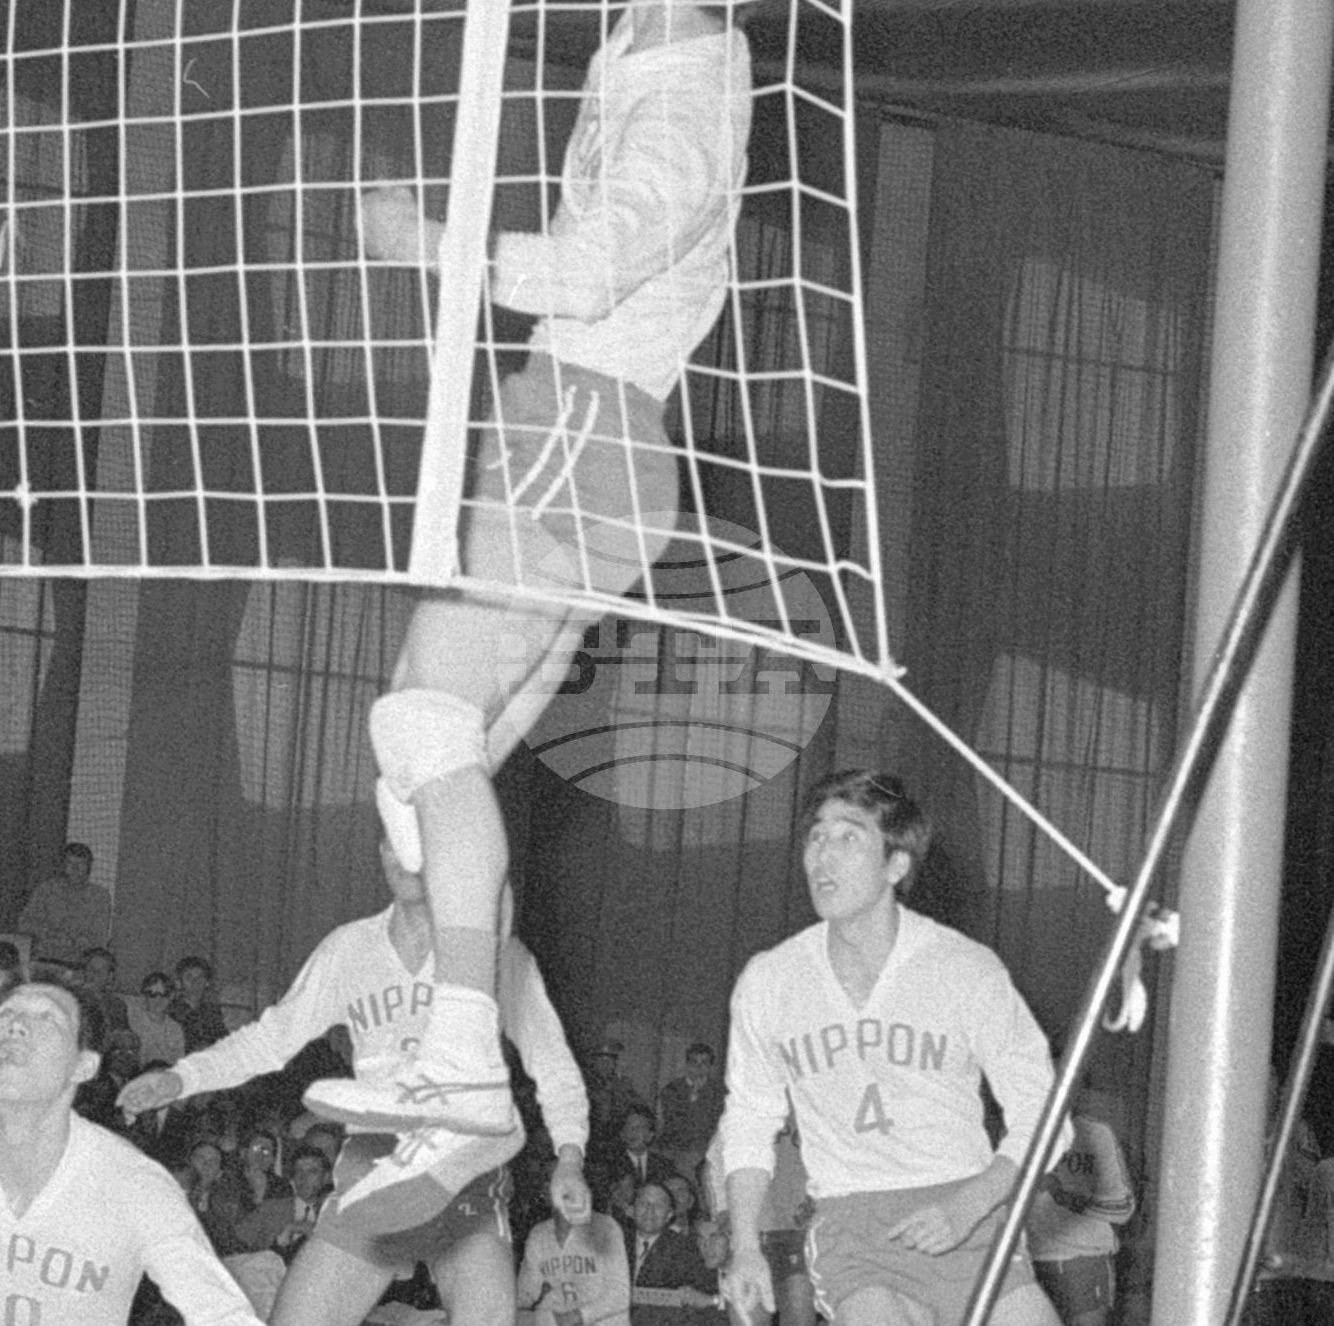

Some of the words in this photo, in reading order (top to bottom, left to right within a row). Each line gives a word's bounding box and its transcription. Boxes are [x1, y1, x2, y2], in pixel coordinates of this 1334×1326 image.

[347, 981, 434, 1033] NIPP
[778, 1018, 948, 1084] NIPPON
[853, 1083, 895, 1136] 4
[539, 1254, 597, 1277] NIPPON
